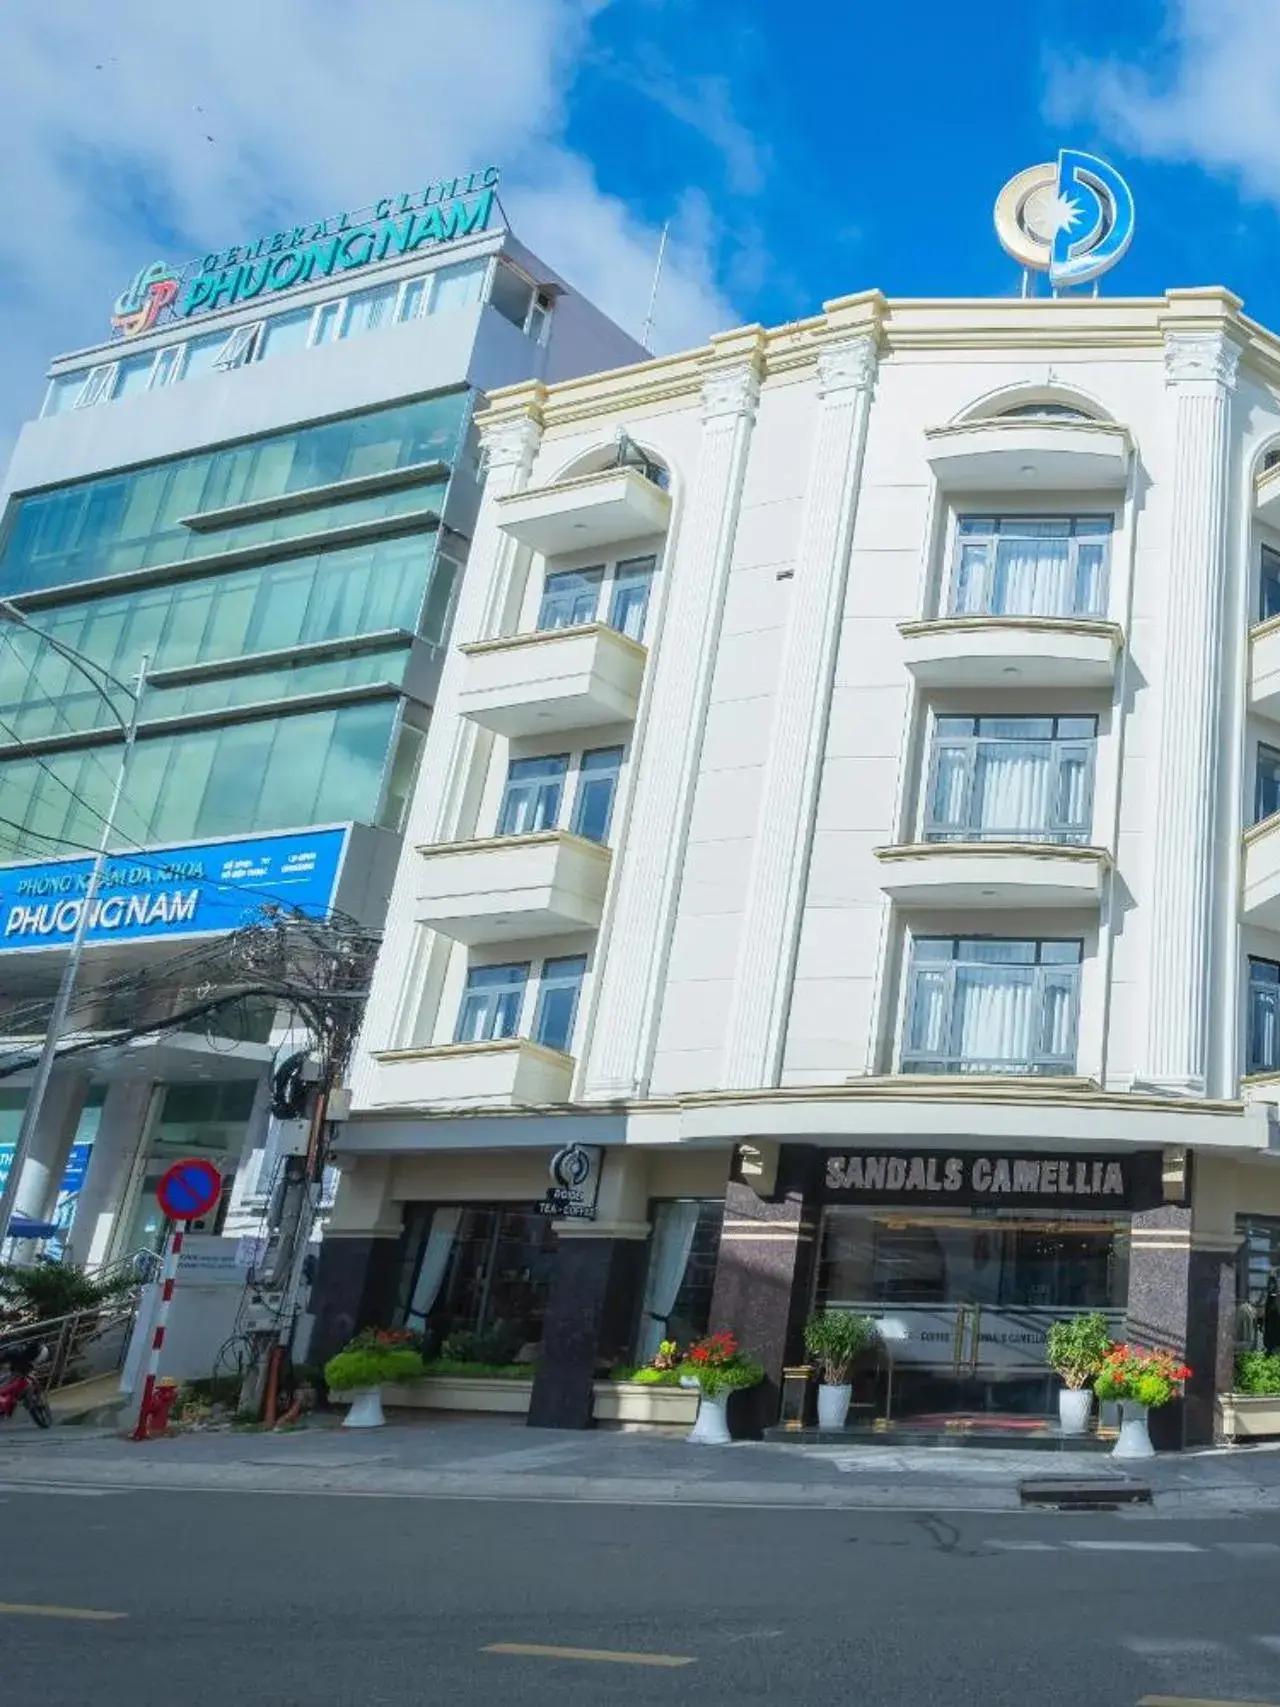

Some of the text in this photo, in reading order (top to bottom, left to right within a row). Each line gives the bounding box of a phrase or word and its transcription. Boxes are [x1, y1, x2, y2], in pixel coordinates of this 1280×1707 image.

[202, 166, 500, 273] GENERAL CLINIC
[825, 1156, 1124, 1195] SANDALS CAMELLIA
